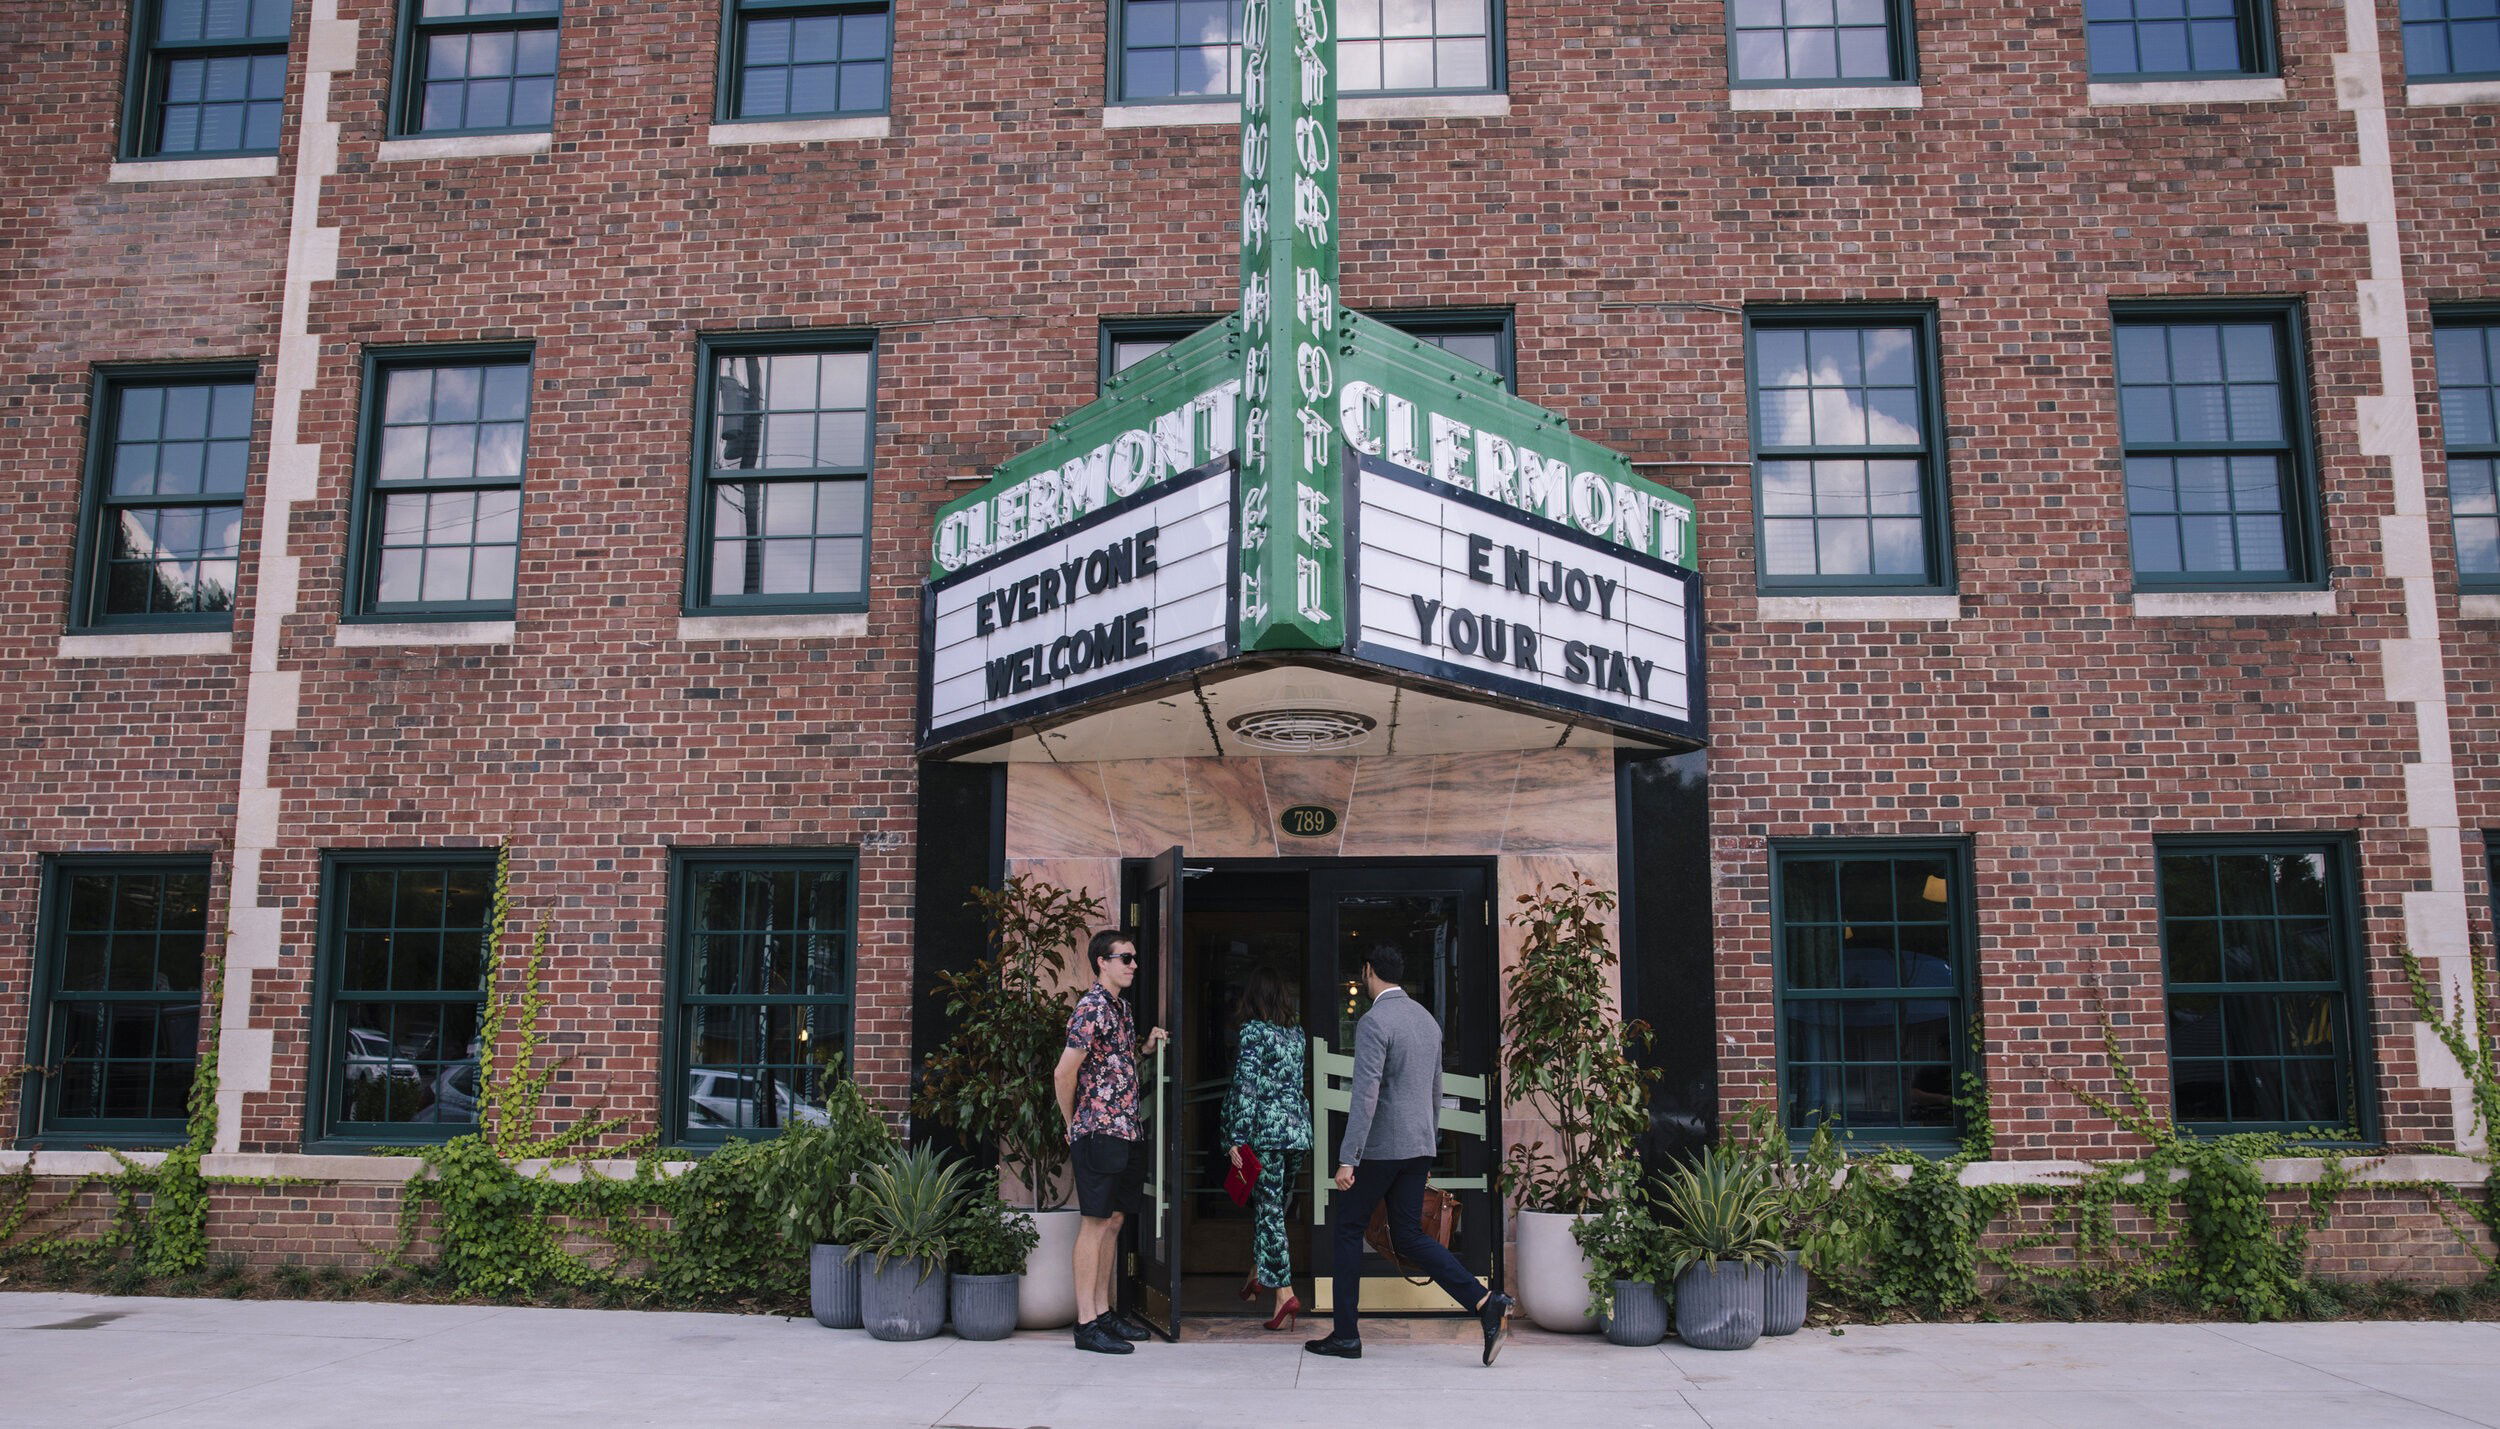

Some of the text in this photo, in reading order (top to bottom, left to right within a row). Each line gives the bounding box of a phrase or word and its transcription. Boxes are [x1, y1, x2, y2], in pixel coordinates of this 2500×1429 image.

[932, 378, 1241, 571] CLERMONT
[1240, 267, 1270, 625] HOTEL
[1296, 266, 1332, 623] HOTEL
[1339, 380, 1693, 565] CLERMONT
[976, 525, 1159, 638] EVERYONE
[1469, 532, 1618, 620] ENJOY
[985, 606, 1149, 701] WELCOME
[1411, 593, 1654, 700] YOUR STAY
[1294, 810, 1325, 832] 789
